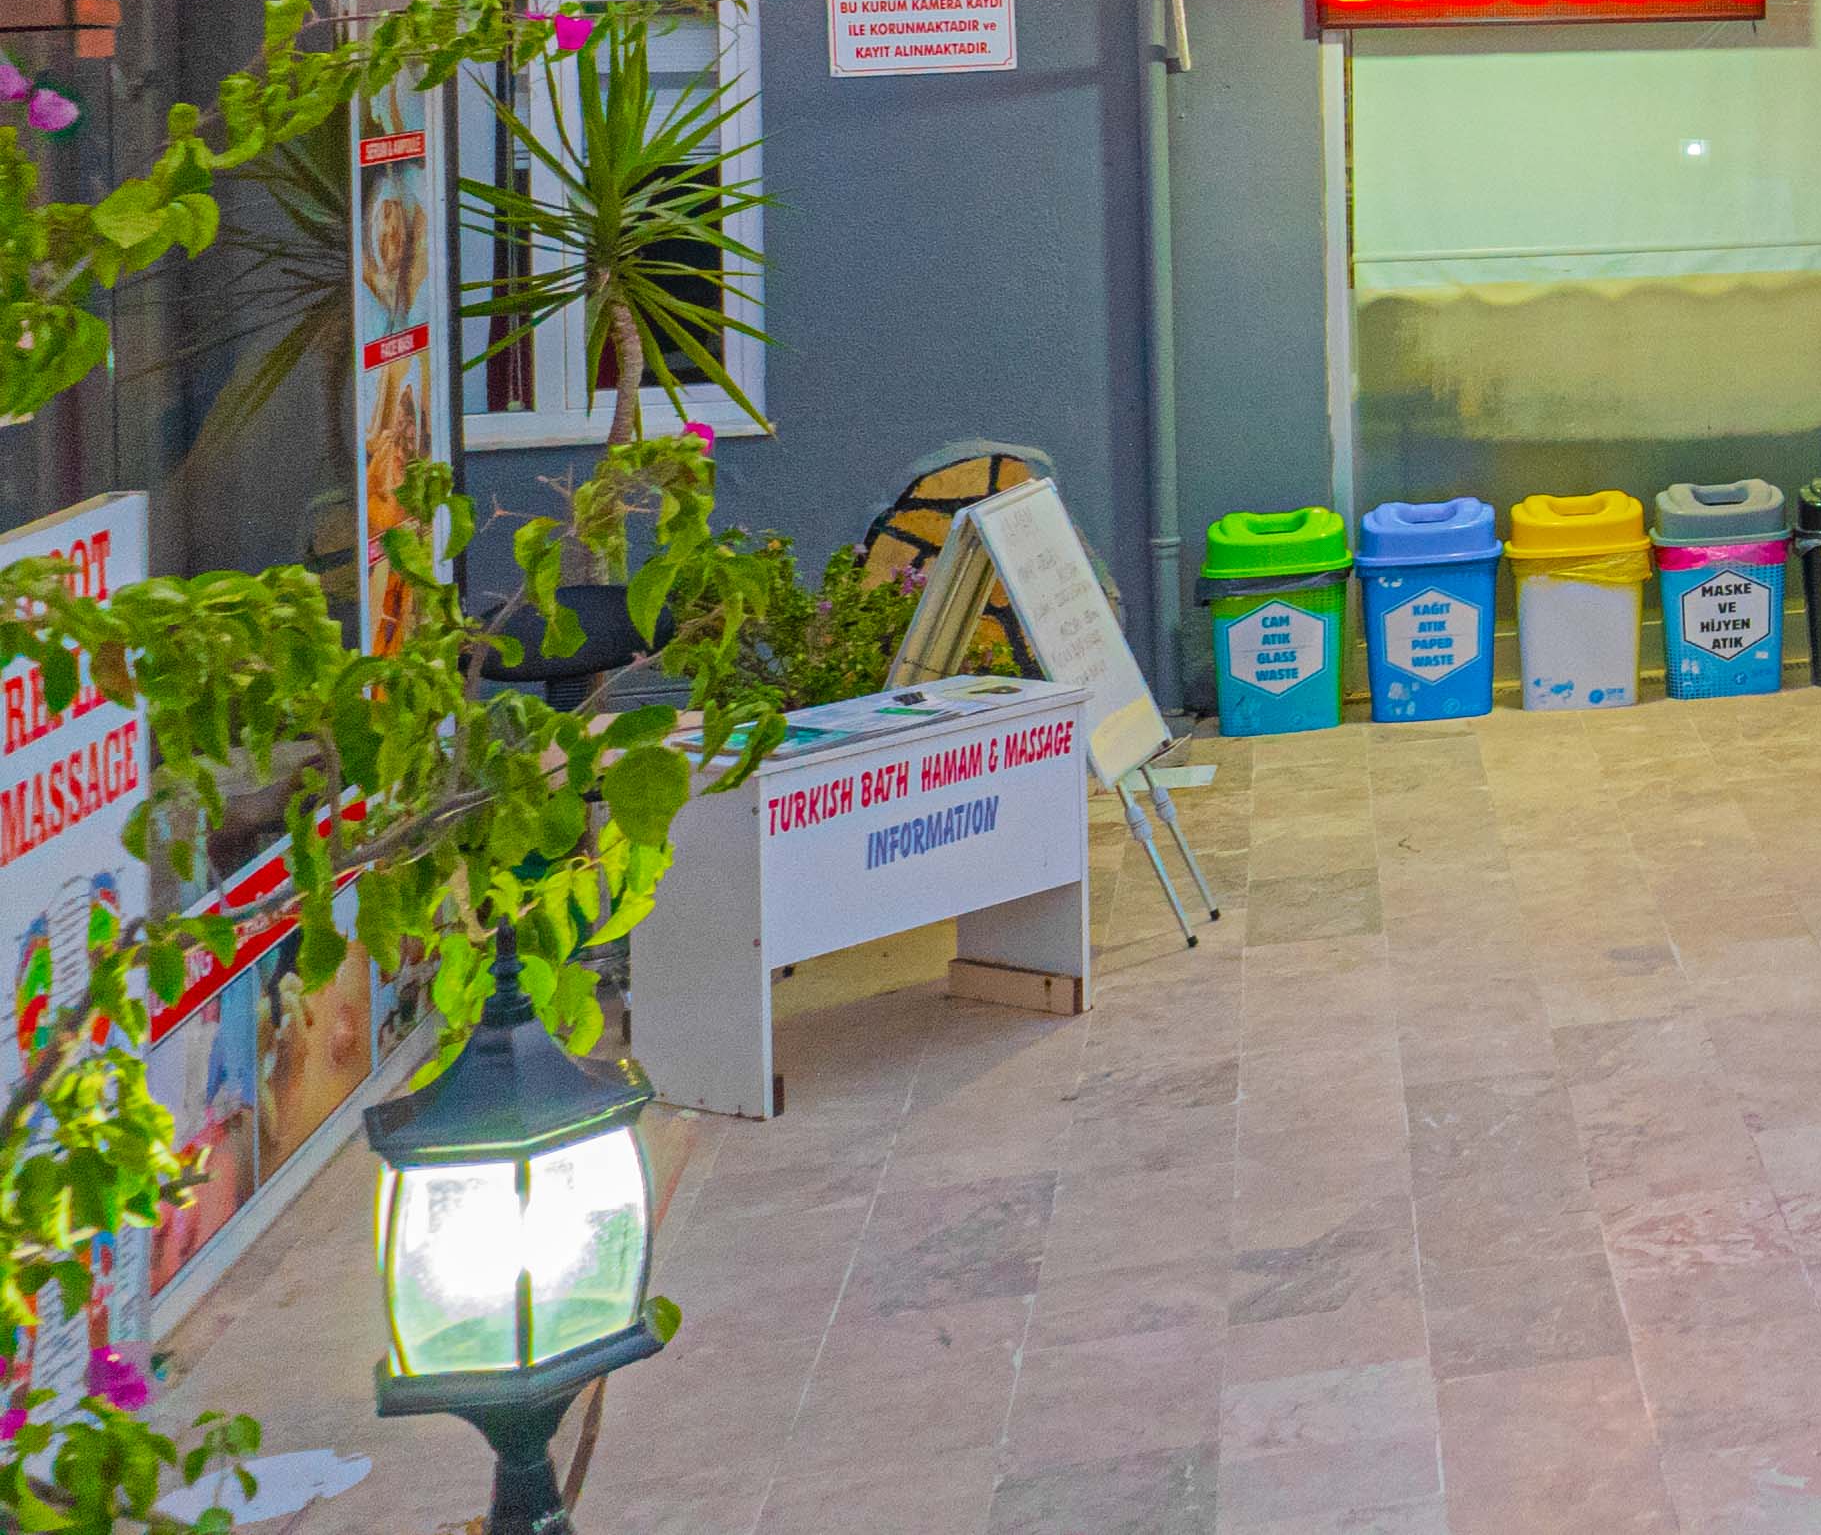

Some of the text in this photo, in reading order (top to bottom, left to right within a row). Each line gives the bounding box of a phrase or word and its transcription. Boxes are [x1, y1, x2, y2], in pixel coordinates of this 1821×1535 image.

[840, 0, 857, 14] BU
[861, 0, 908, 13] KURUM
[869, 20, 979, 36] KORUNMAKTADIR
[982, 21, 997, 31] ve
[855, 42, 992, 59] KAYIT ALINMAKTADIR.
[1701, 582, 1752, 597] MASKE
[1718, 602, 1737, 613] VE
[1261, 615, 1290, 628] CAM
[1417, 621, 1446, 633] ATIK
[1261, 633, 1291, 645] ATIK
[1411, 637, 1453, 650] PAPER
[1711, 637, 1744, 649] ATIK
[1256, 650, 1297, 664] GLASS
[1411, 654, 1454, 667] WASTE
[1255, 668, 1299, 681] WASTE
[768, 721, 1074, 836] TURKISH BATH HAMAM & MASSAGE
[0, 719, 138, 866] MASSAGE
[867, 795, 999, 870] INFORMATION
